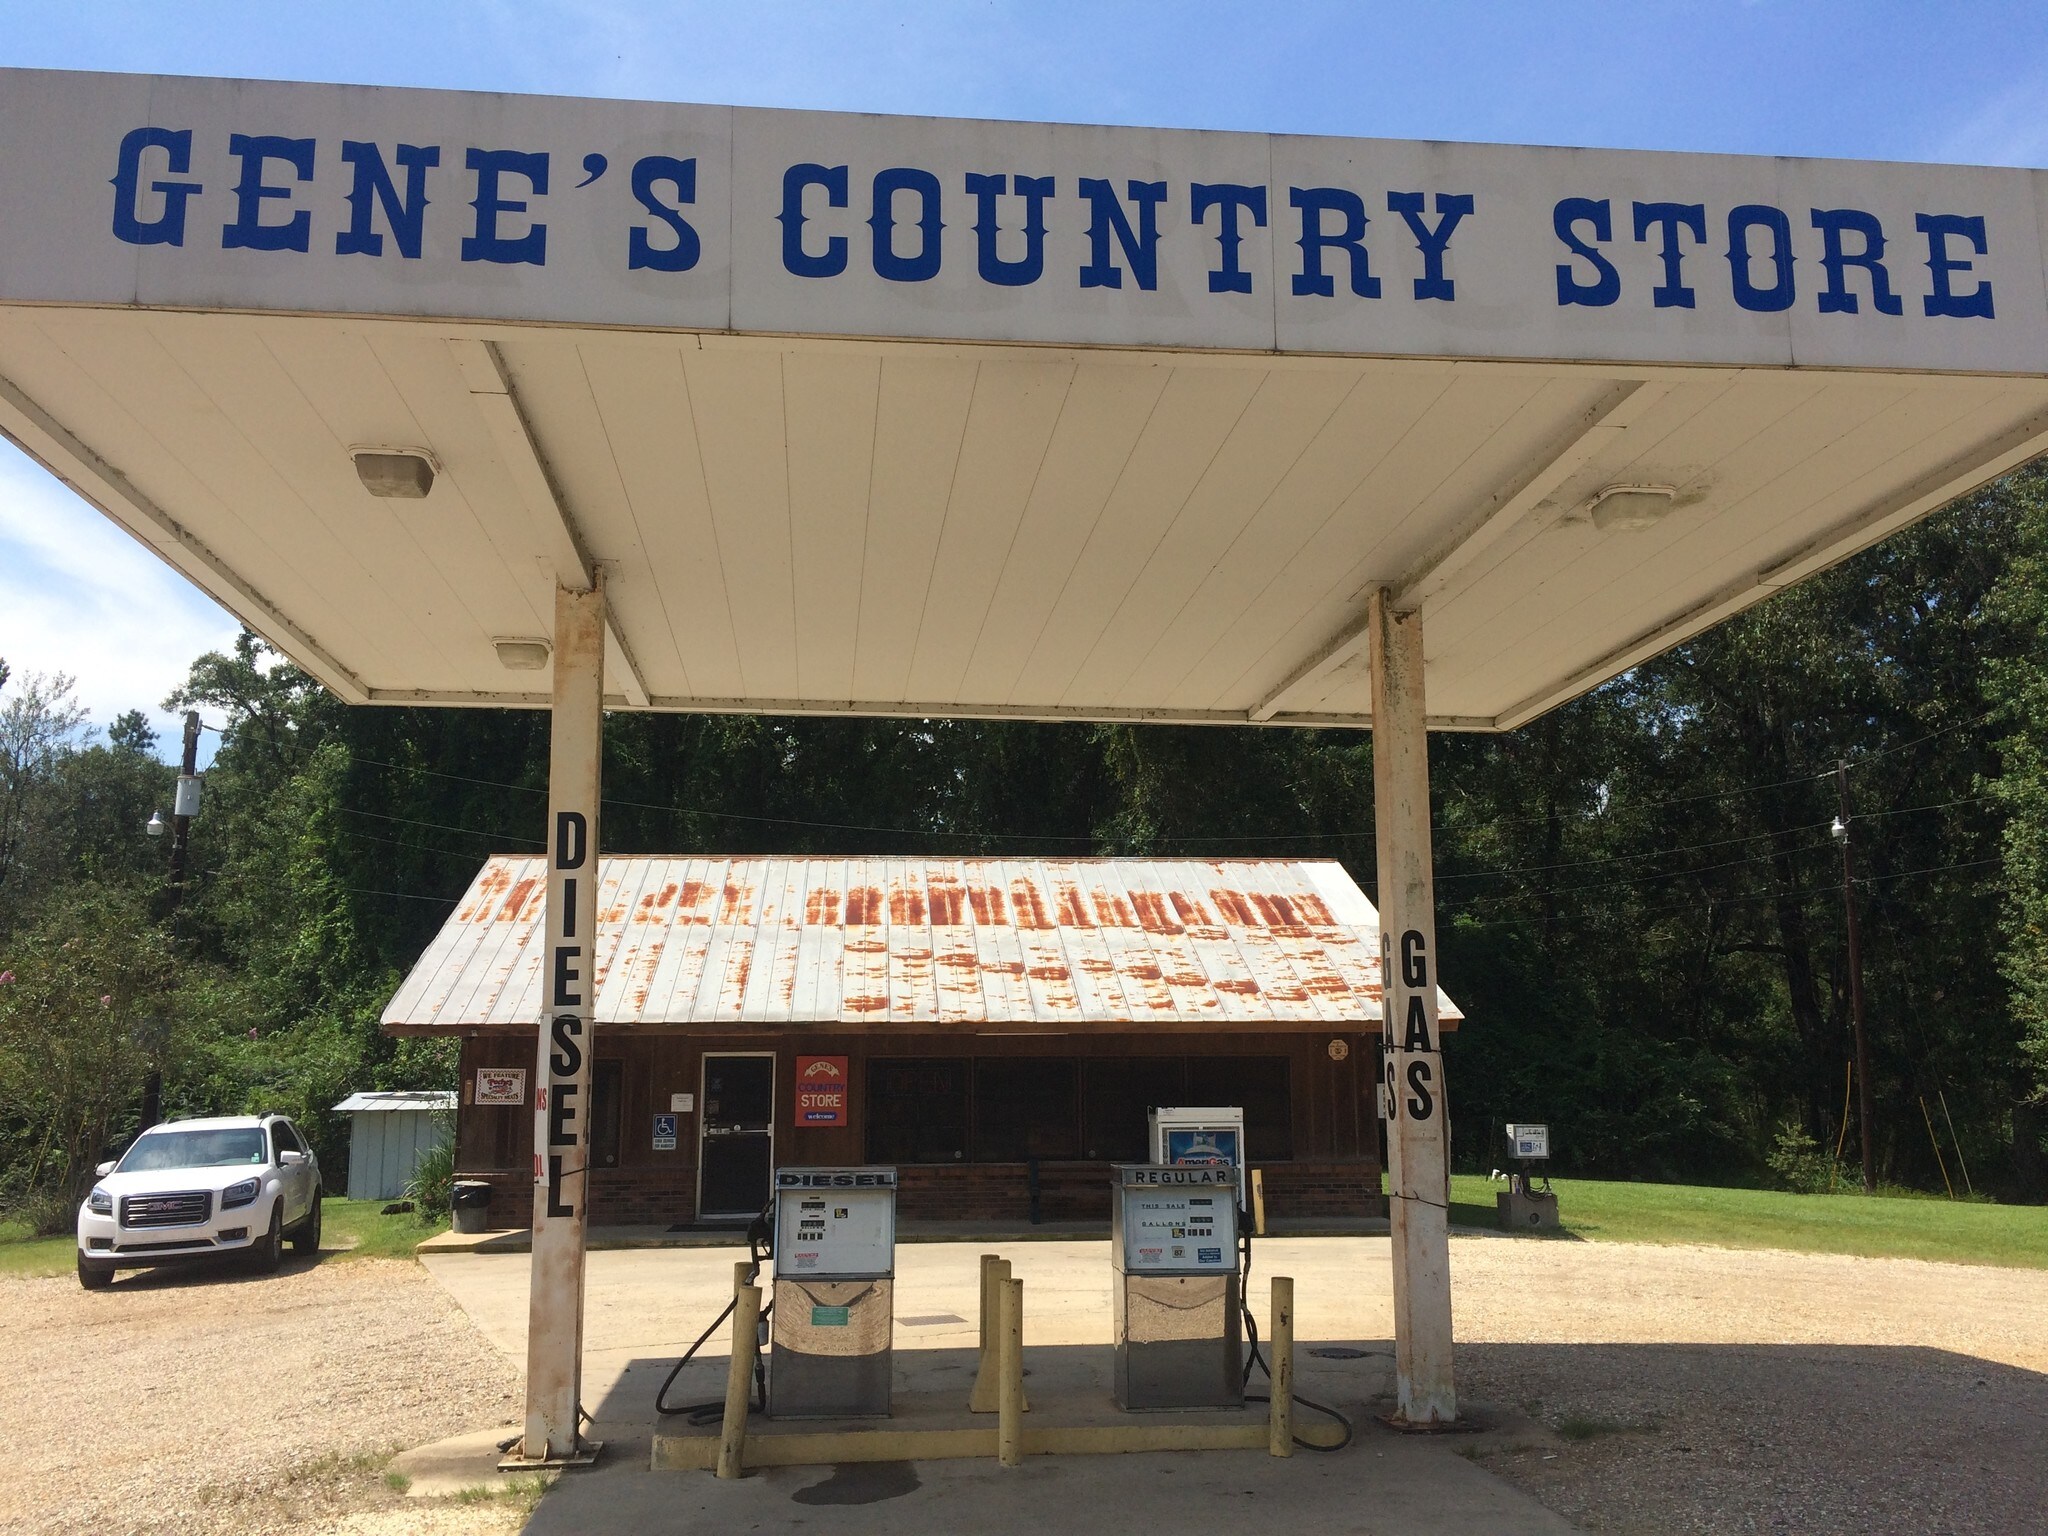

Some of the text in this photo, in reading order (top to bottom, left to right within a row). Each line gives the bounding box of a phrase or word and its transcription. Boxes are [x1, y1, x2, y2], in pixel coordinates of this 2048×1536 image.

[108, 127, 1996, 320] GENE'S COUNTRY STORE
[547, 812, 587, 1217] DIESEL
[1401, 930, 1433, 1121] GAS
[798, 1083, 845, 1092] COUNTRY
[801, 1094, 842, 1107] STORE
[807, 1112, 835, 1120] welcome
[779, 1174, 893, 1186] DIESEL
[1135, 1171, 1226, 1184] REGULAR
[148, 1200, 183, 1211] GMC
[1174, 1249, 1183, 1257] 87
